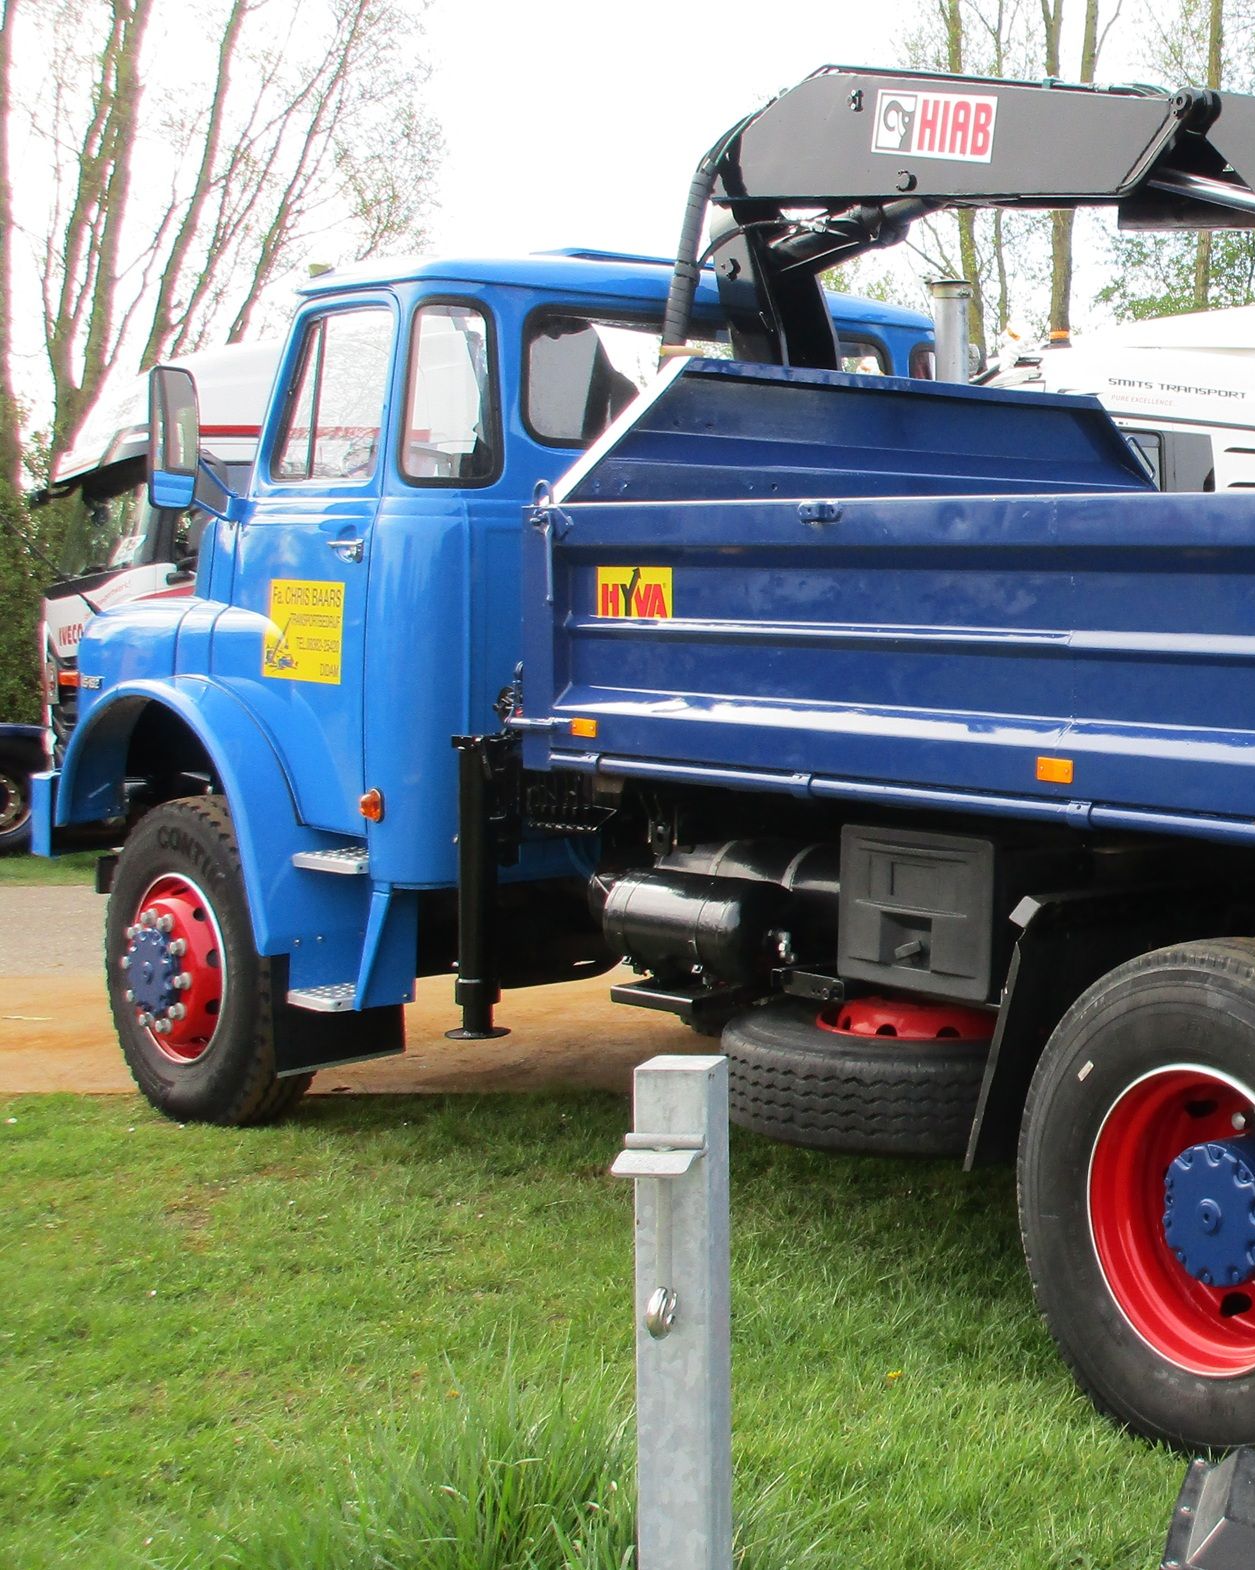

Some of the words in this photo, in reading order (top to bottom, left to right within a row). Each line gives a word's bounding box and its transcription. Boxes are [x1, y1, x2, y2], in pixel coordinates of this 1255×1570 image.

[917, 100, 992, 155] HIAB
[1108, 378, 1153, 389] SMITS
[1158, 382, 1247, 399] TRANSPORT
[1111, 394, 1130, 402] PURE
[285, 586, 310, 605] CHRIS
[312, 588, 342, 608] BAARS
[601, 568, 668, 618] HYVA
[59, 623, 84, 647] IVECO
